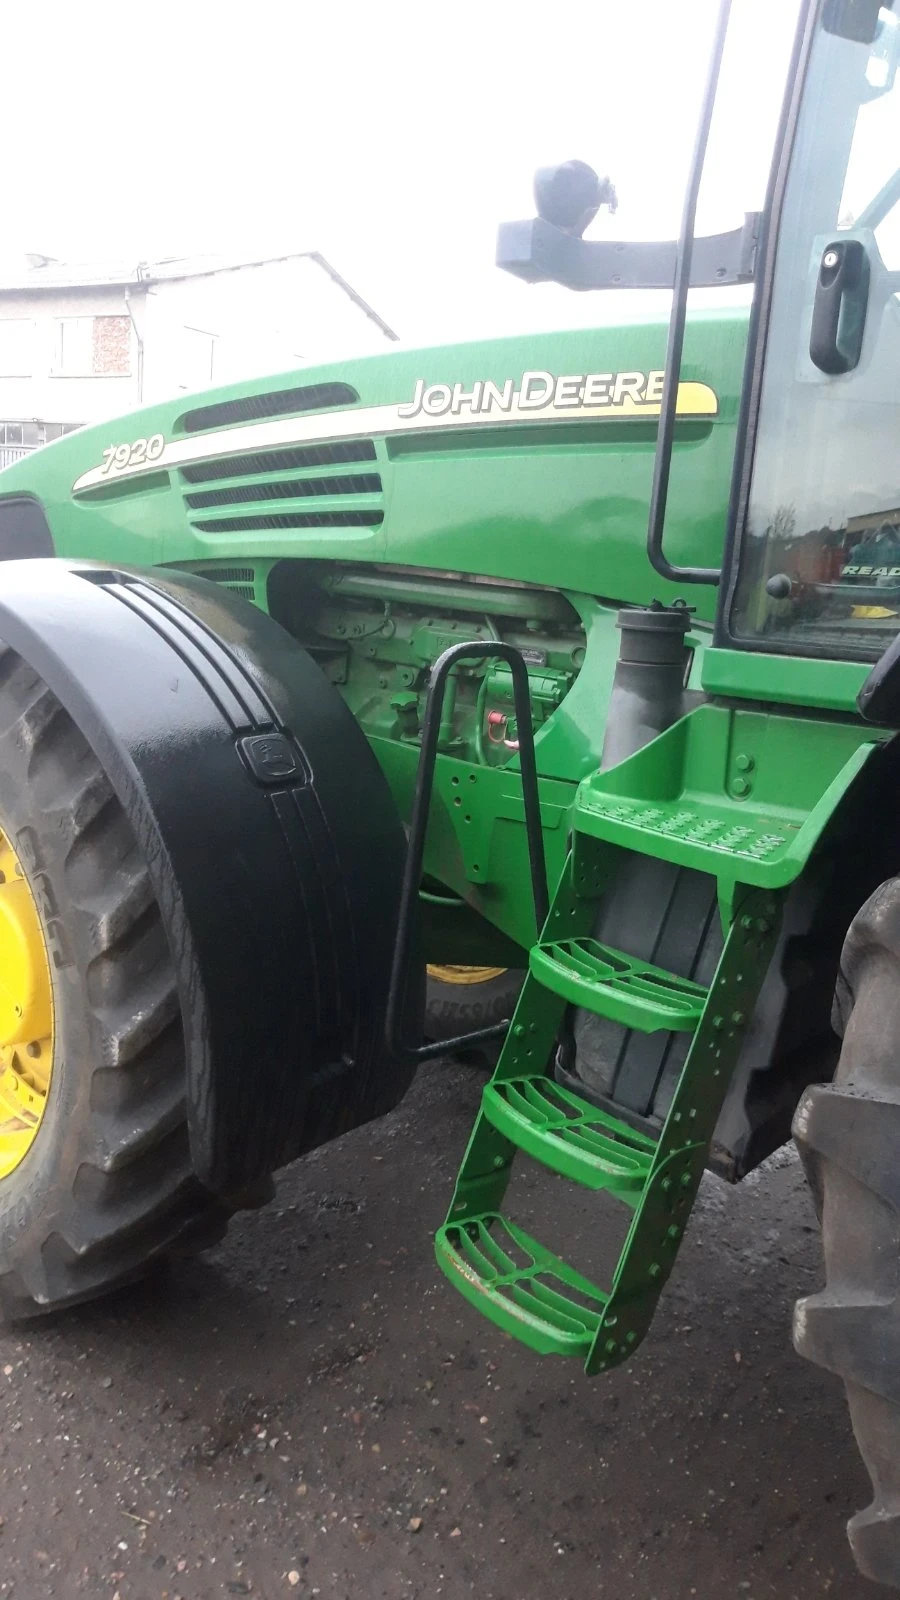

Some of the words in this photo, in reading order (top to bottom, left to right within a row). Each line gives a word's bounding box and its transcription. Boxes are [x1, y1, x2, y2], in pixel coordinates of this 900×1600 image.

[398, 379, 514, 418] JOHN
[518, 371, 666, 411] DEERE
[102, 433, 165, 474] 7920
